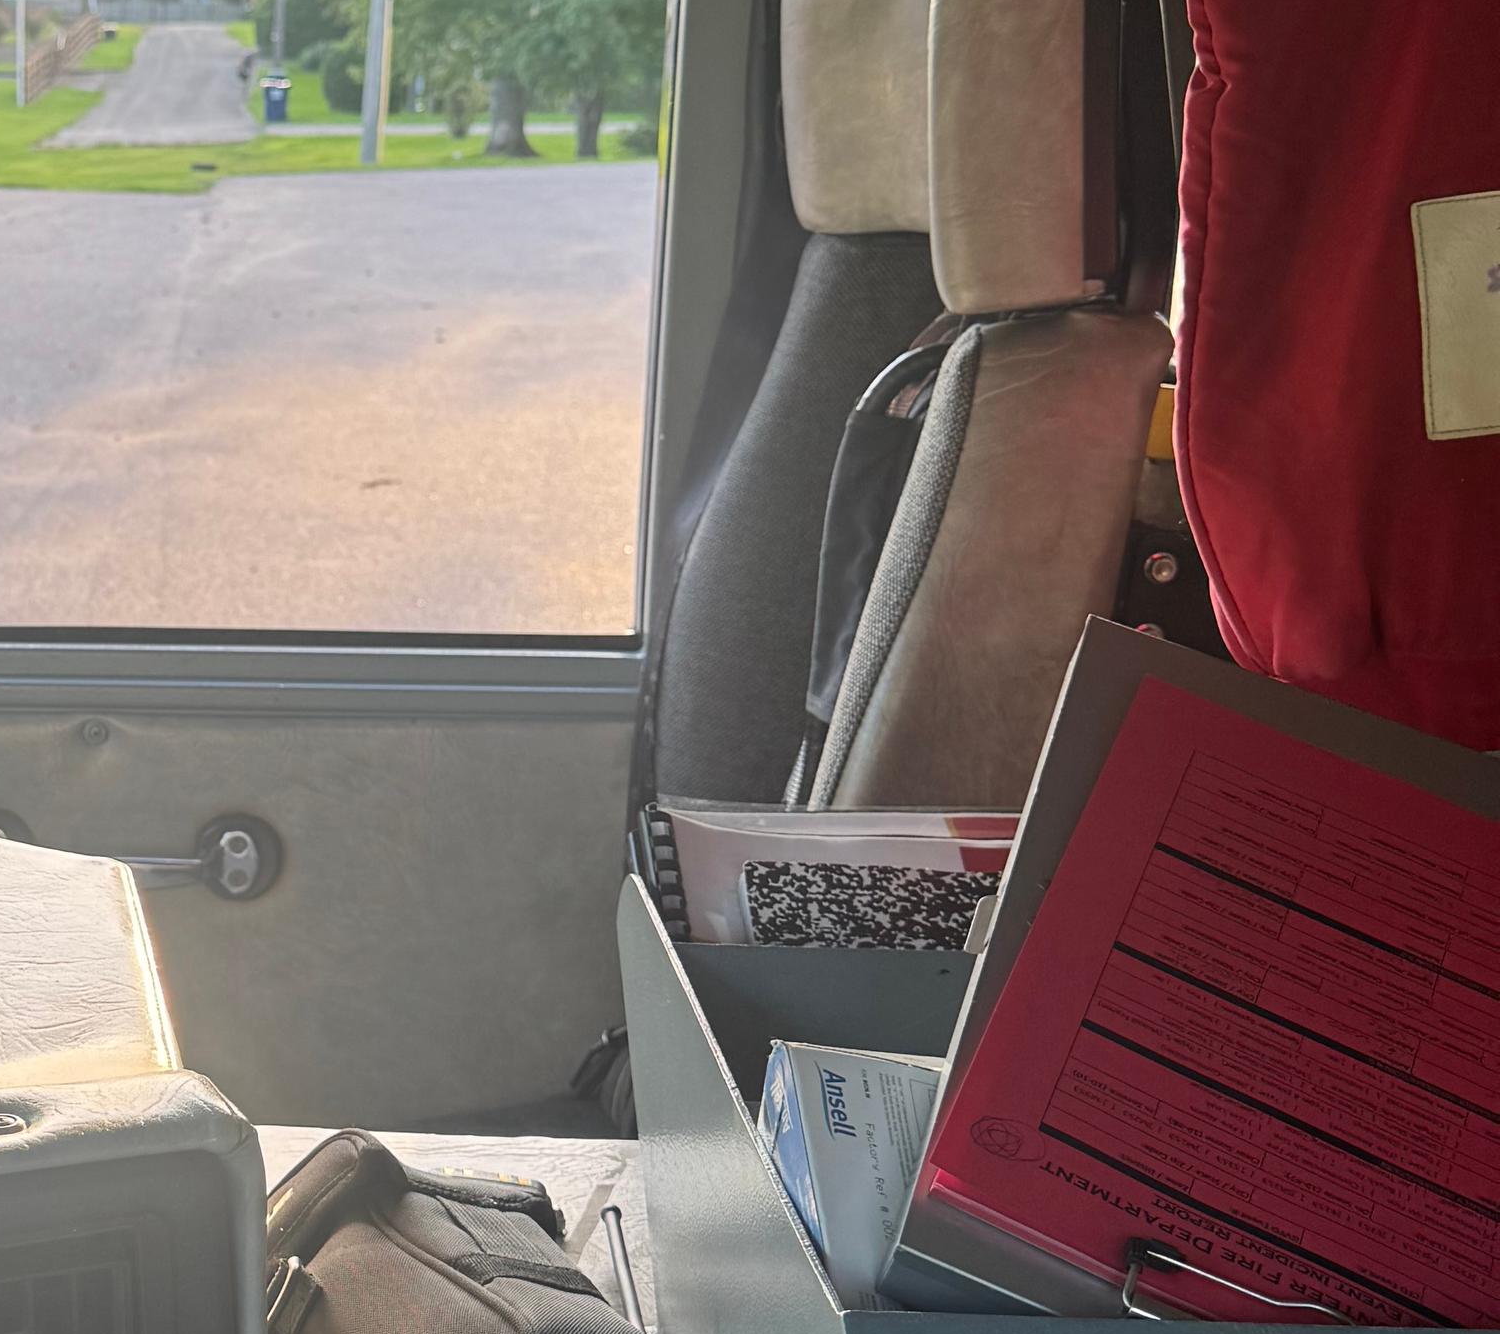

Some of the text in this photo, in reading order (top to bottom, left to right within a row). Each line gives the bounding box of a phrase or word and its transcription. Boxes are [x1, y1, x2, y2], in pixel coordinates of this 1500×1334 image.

[821, 1066, 856, 1141] Ansell
[863, 1122, 881, 1172] Factory
[873, 1176, 886, 1197] Ref
[1038, 1156, 1214, 1254] DEPARTMENT
[1149, 1194, 1403, 1322] EVENT INCIDENT REPORT
[1216, 1242, 1284, 1286] FIRE
